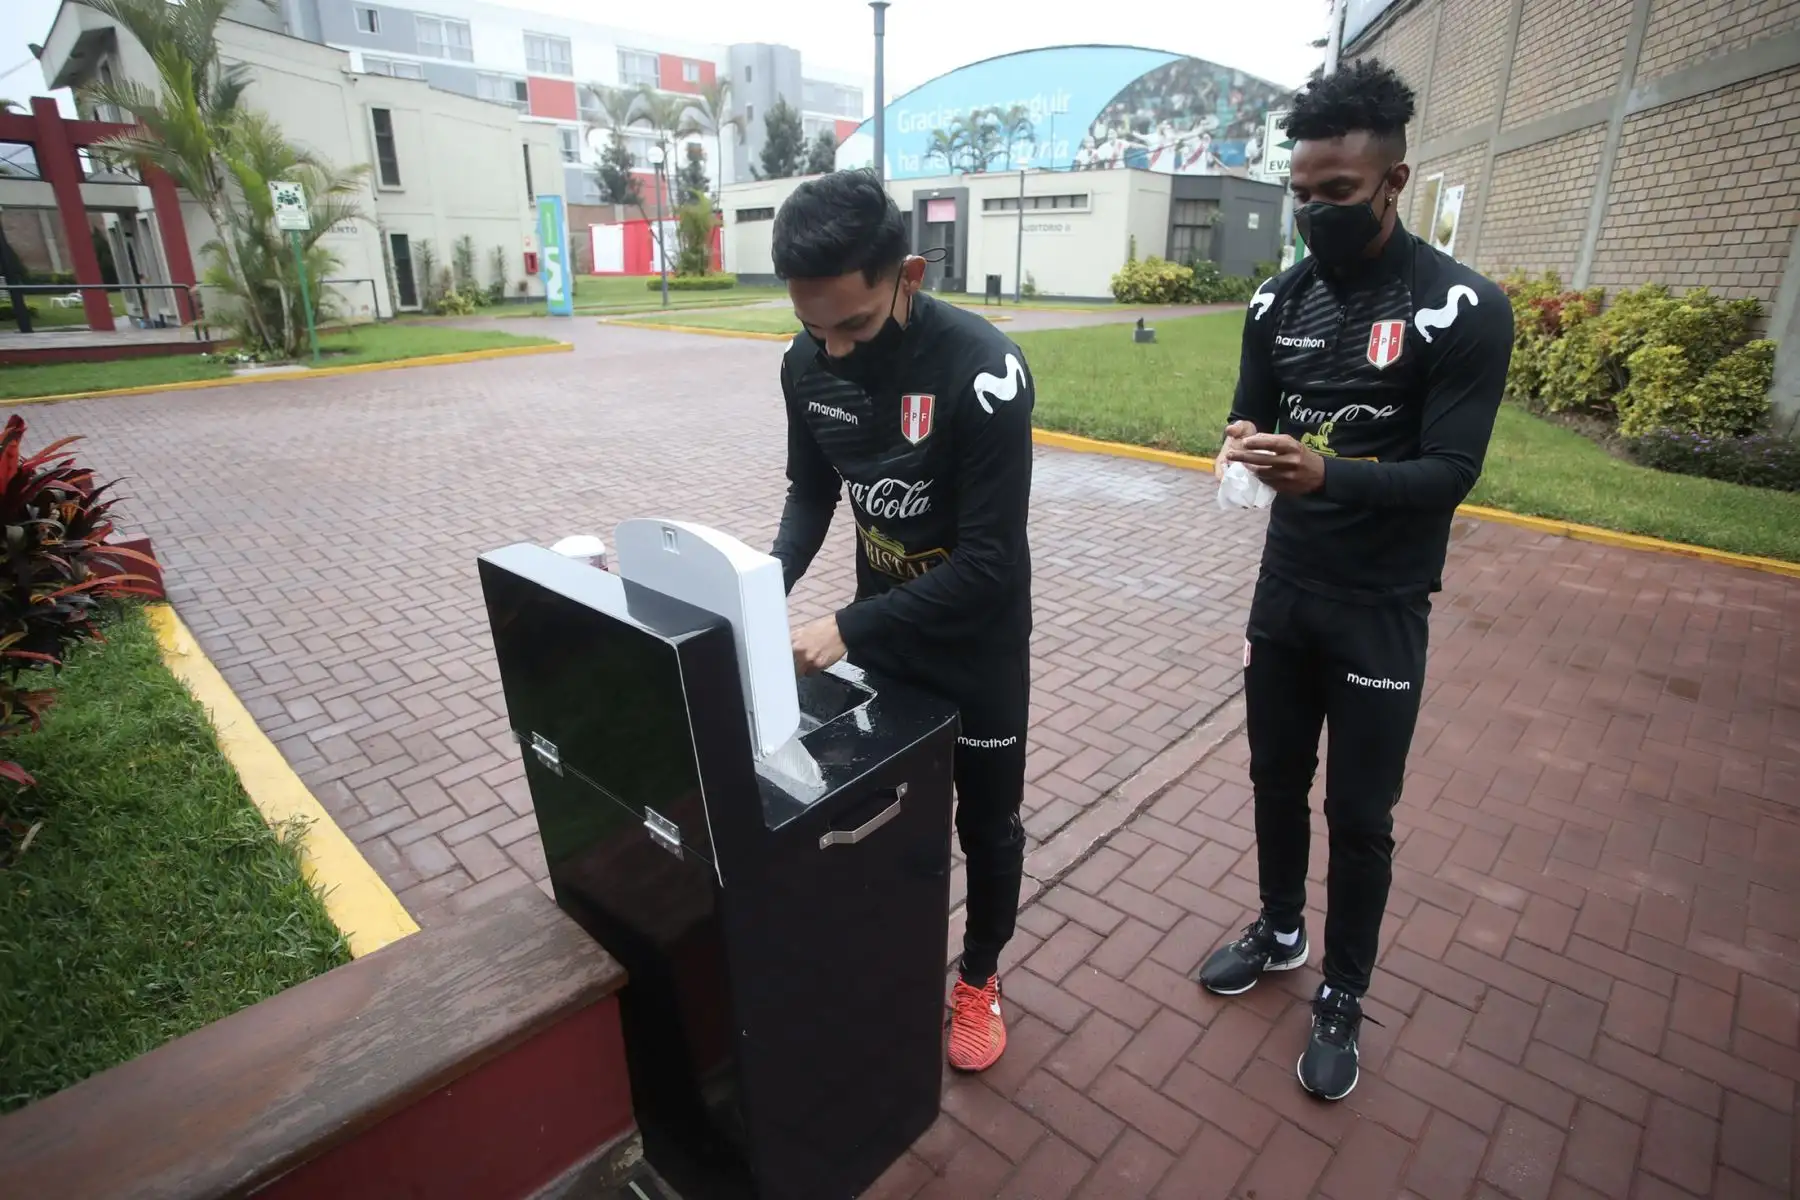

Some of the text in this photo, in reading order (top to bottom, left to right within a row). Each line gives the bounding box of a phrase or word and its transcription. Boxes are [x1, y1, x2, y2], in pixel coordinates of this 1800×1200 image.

[808, 401, 859, 426] marathon
[1347, 672, 1410, 690] marathon
[957, 736, 1017, 748] marathon
